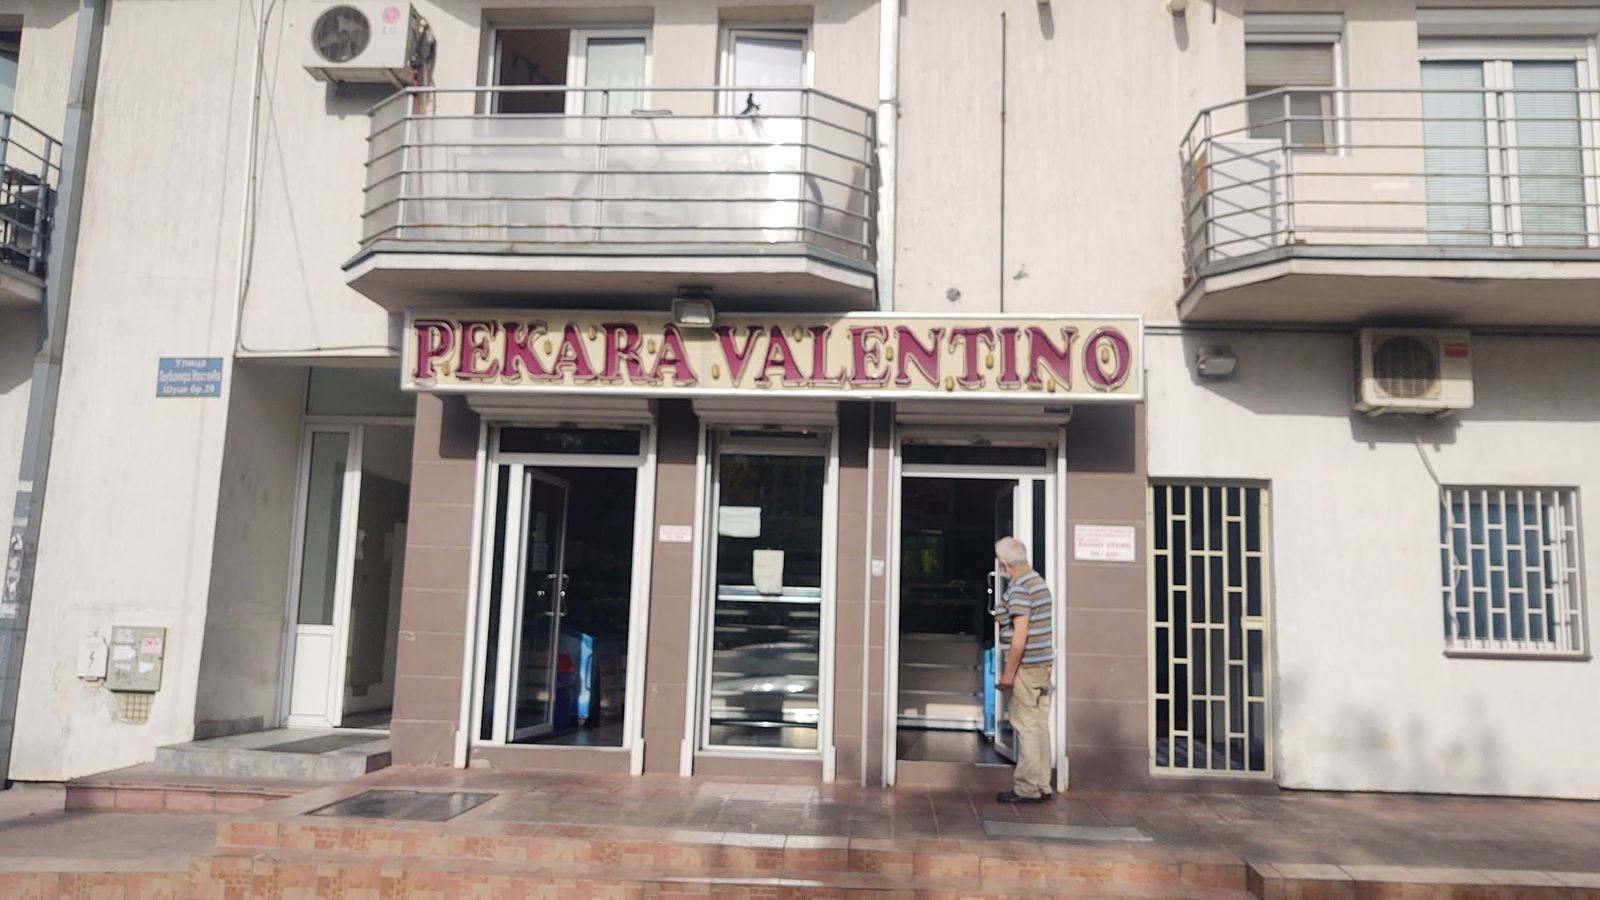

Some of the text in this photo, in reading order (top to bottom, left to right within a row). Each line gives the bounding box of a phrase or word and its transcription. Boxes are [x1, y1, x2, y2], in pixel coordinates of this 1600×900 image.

[175, 359, 207, 368] Улица
[413, 319, 1132, 392] PEKARA VALENTINO
